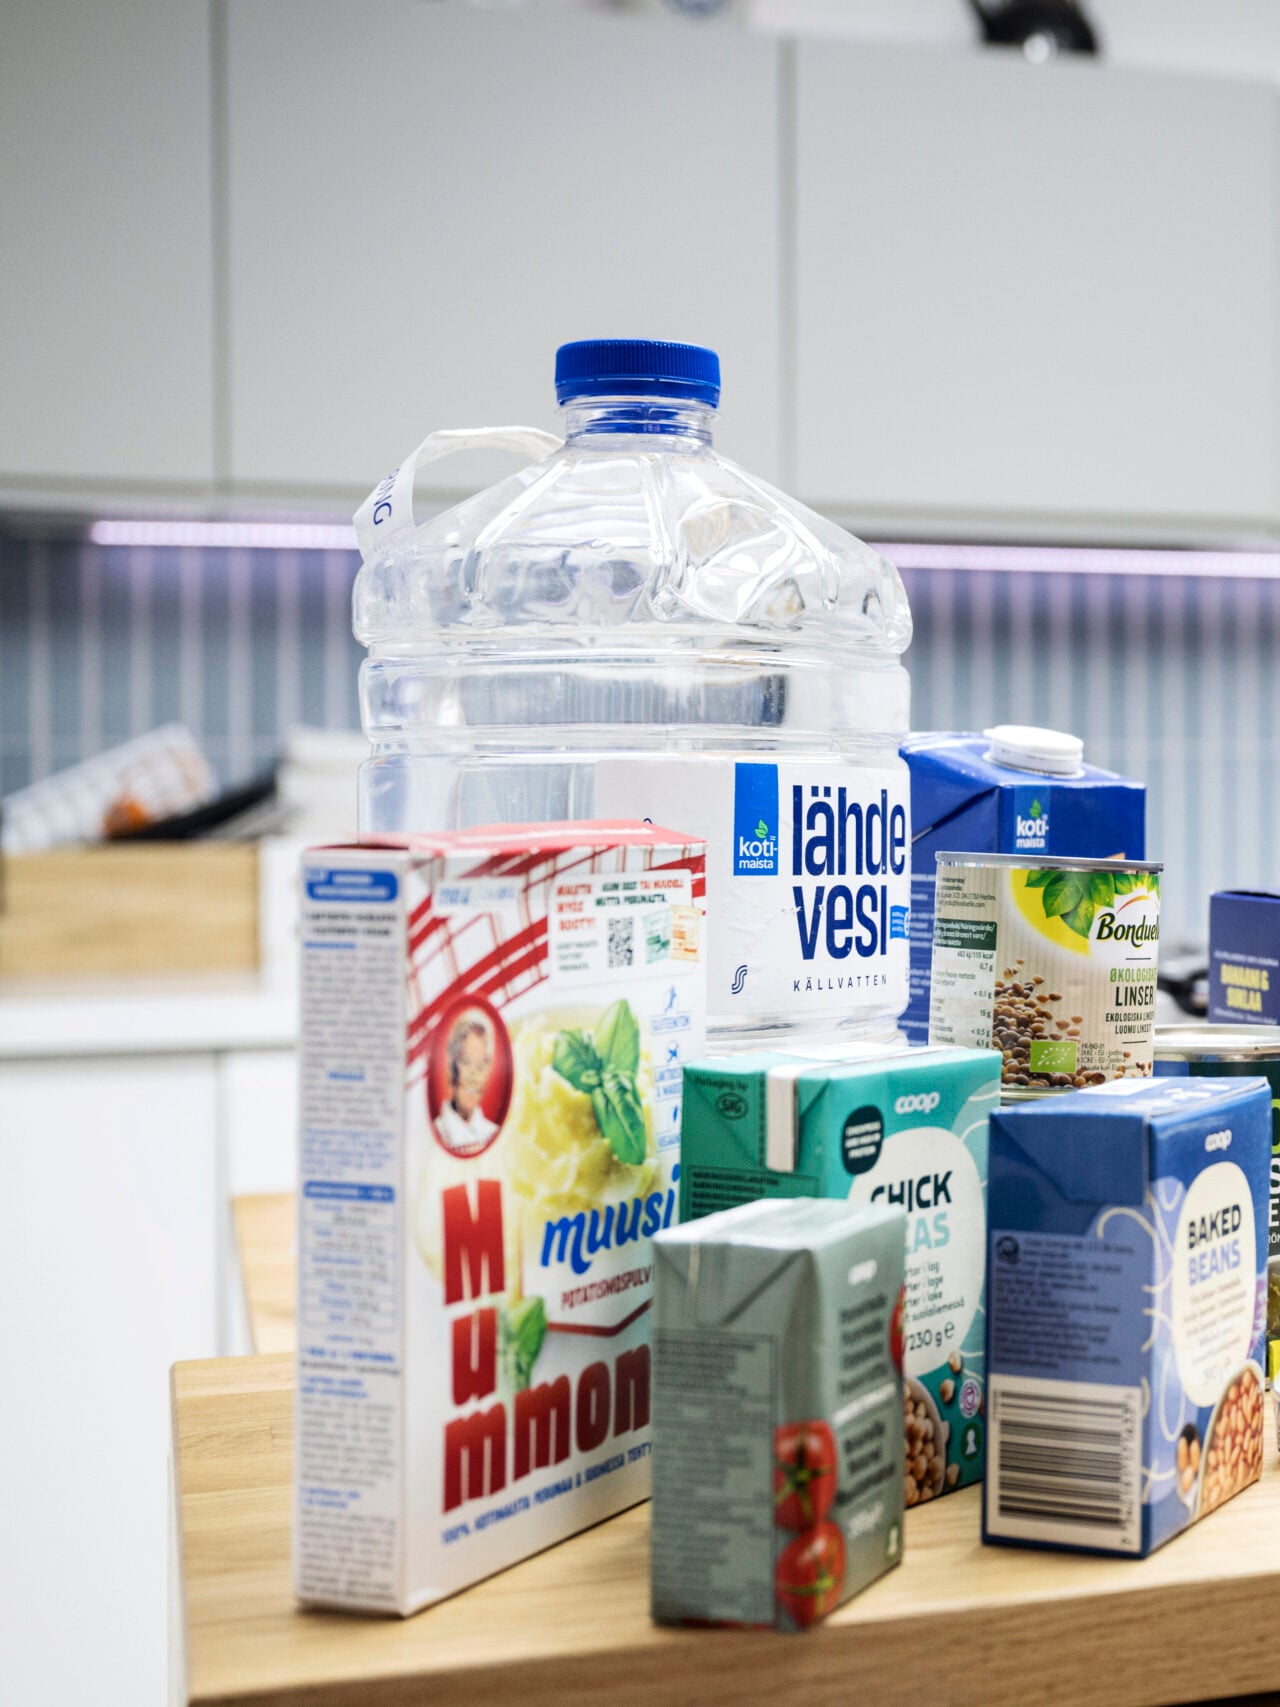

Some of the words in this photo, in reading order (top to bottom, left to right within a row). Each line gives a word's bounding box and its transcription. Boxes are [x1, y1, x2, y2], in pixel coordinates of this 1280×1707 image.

[792, 784, 906, 876] lähde
[1016, 837, 1046, 849] maista
[738, 857, 774, 870] maista
[793, 884, 888, 960] vesi
[793, 974, 888, 992] KÄLLVATTEN
[1115, 985, 1154, 1007] LINSER
[1105, 1012, 1142, 1023] EKOLOGISKA
[1115, 1024, 1137, 1034] LUOMU
[894, 1091, 940, 1114] coop
[1204, 1128, 1233, 1152] coop
[541, 1163, 681, 1275] muusi
[1188, 1204, 1242, 1250] BAKED
[905, 1211, 951, 1255] AS
[1188, 1238, 1242, 1287] BEANS
[561, 1264, 654, 1311] POTATISMOSPULV
[934, 1330, 943, 1348] g
